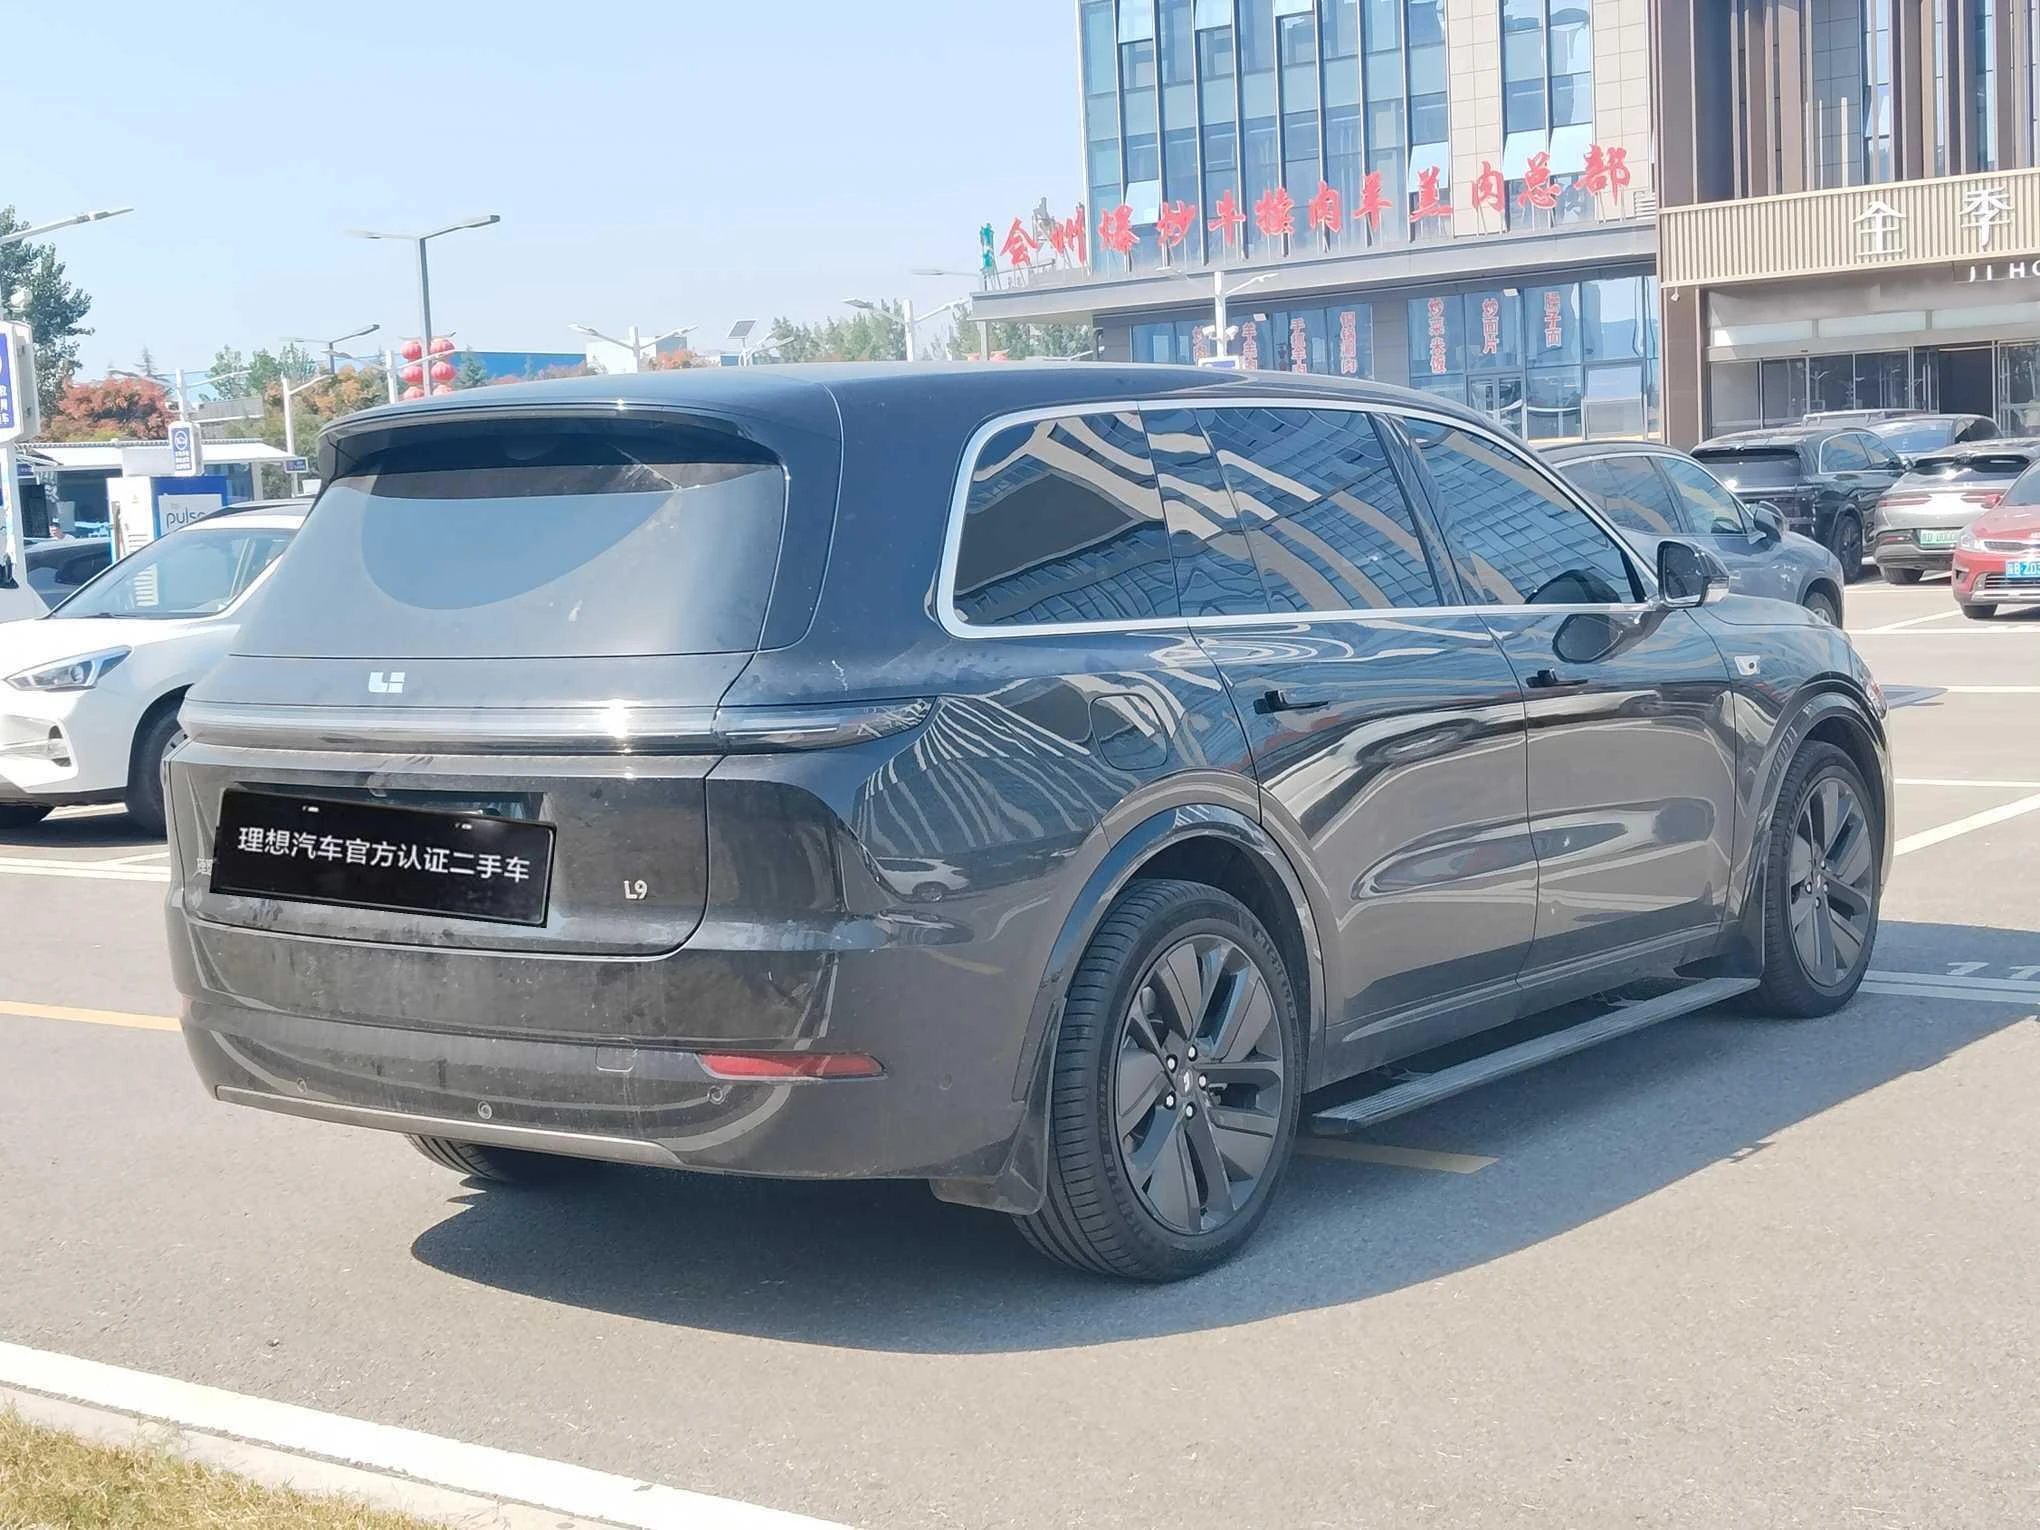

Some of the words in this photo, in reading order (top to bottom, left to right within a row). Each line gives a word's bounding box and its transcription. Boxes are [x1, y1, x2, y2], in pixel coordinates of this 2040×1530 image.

[238, 826, 531, 883] 理想汽车官方认证二手车
[624, 880, 647, 899] L9
